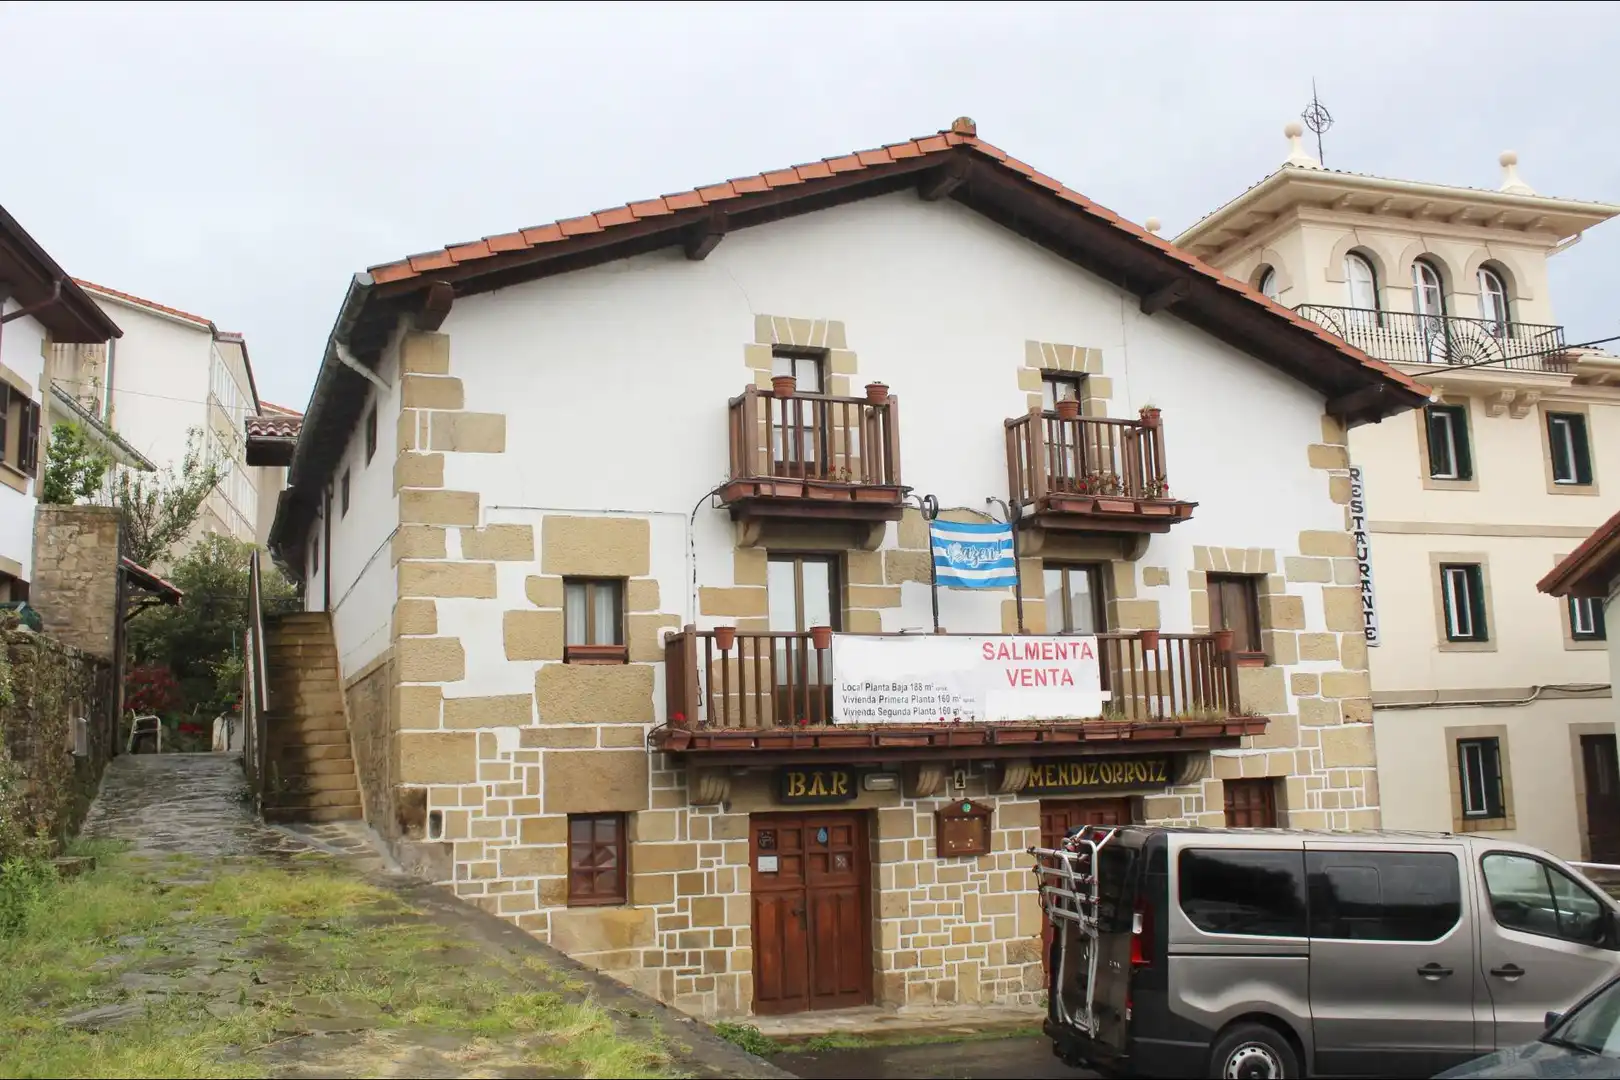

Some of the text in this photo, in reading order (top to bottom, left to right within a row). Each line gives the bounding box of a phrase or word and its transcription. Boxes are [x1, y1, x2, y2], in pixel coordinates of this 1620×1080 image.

[1349, 467, 1377, 641] RESTAURANTE
[982, 641, 1094, 661] SALMENTA
[1005, 668, 1074, 687] VENTA
[842, 682, 863, 692] Local
[865, 682, 890, 692] Planta
[891, 682, 908, 693] Baja
[842, 695, 876, 704] Vivienda
[878, 694, 909, 704] Primera
[911, 694, 935, 704] Planta
[843, 707, 876, 716] Vivienda
[877, 707, 911, 718] Segunda
[913, 707, 937, 716] Planta
[955, 771, 965, 788] 4
[1026, 760, 1168, 787] MENDIZORROTZ
[787, 771, 848, 797] BAR
